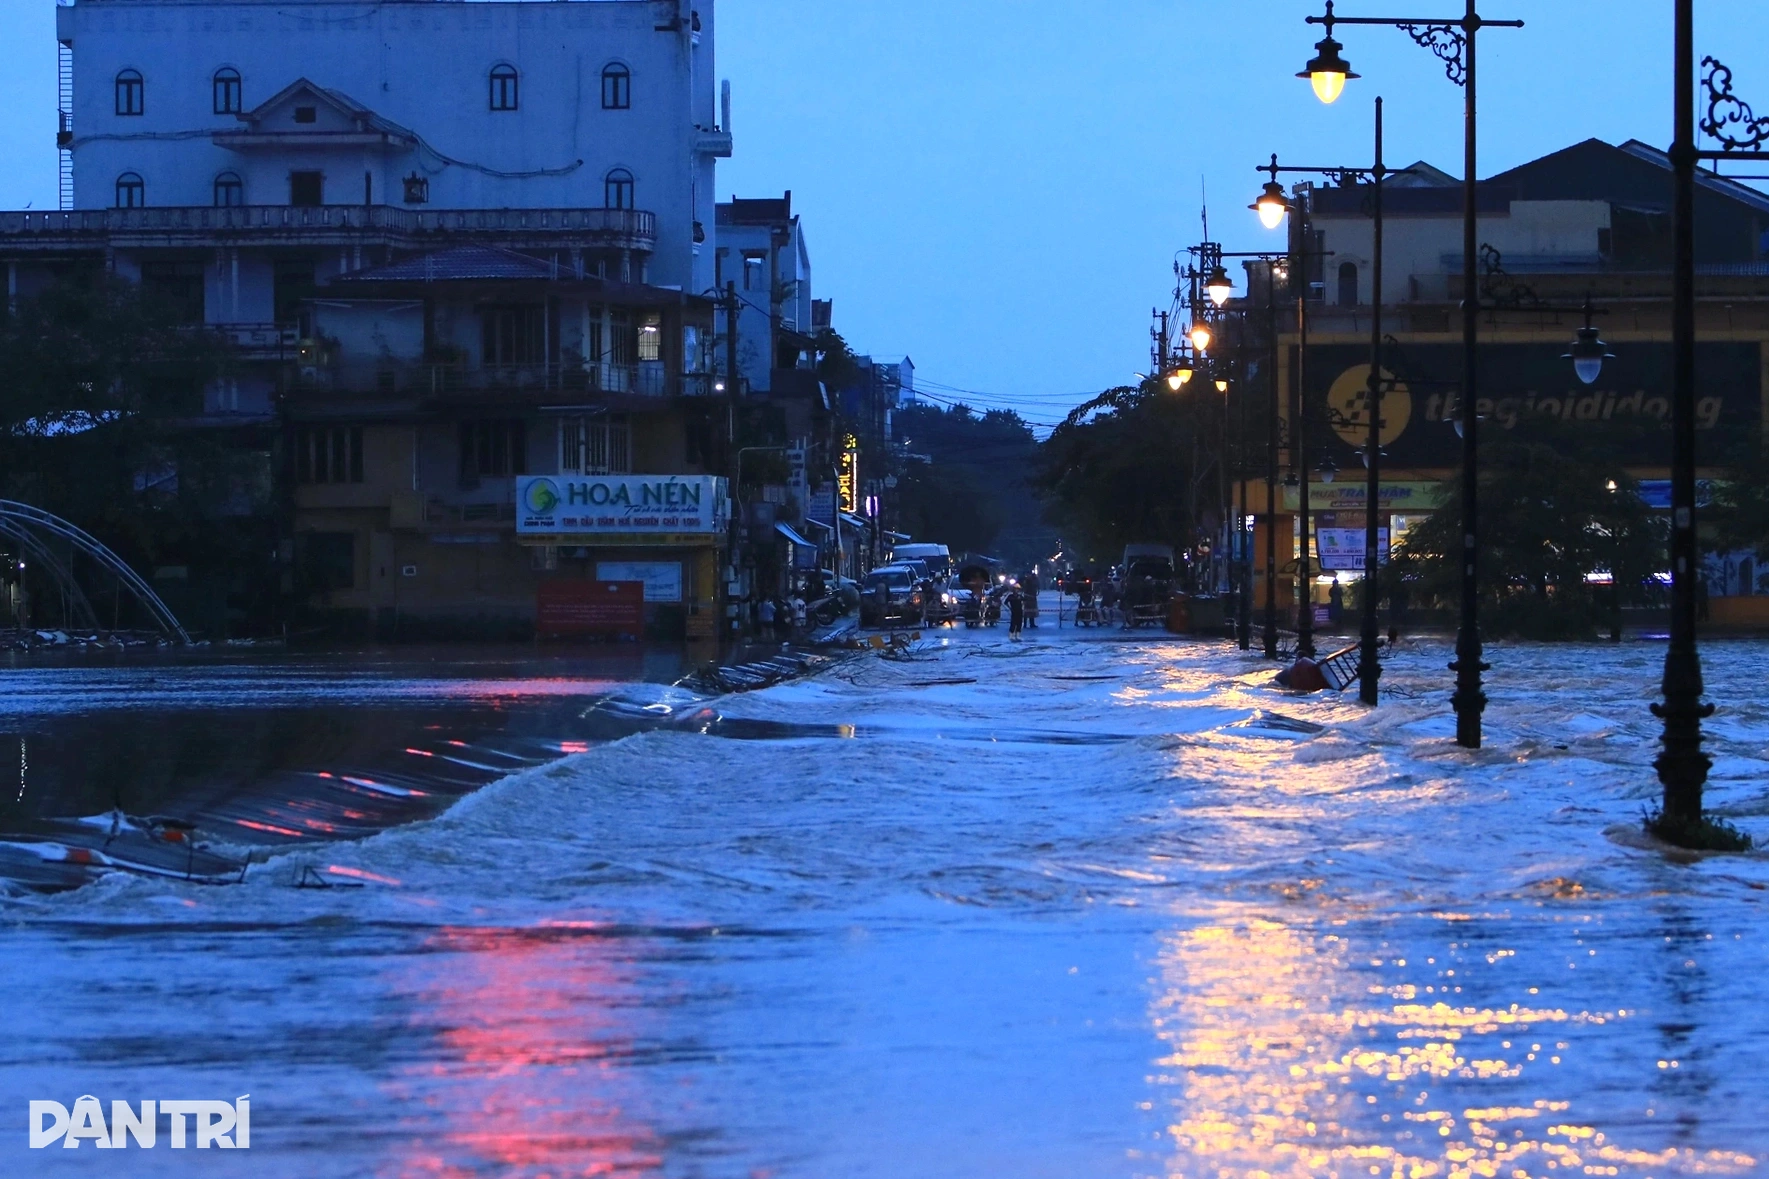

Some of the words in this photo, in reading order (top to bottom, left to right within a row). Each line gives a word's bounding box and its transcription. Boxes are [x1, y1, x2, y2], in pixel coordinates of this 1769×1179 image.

[1425, 389, 1722, 429] thegioididog
[568, 482, 631, 506] HOA
[641, 474, 701, 506] NÉN
[1310, 489, 1336, 499] MUA
